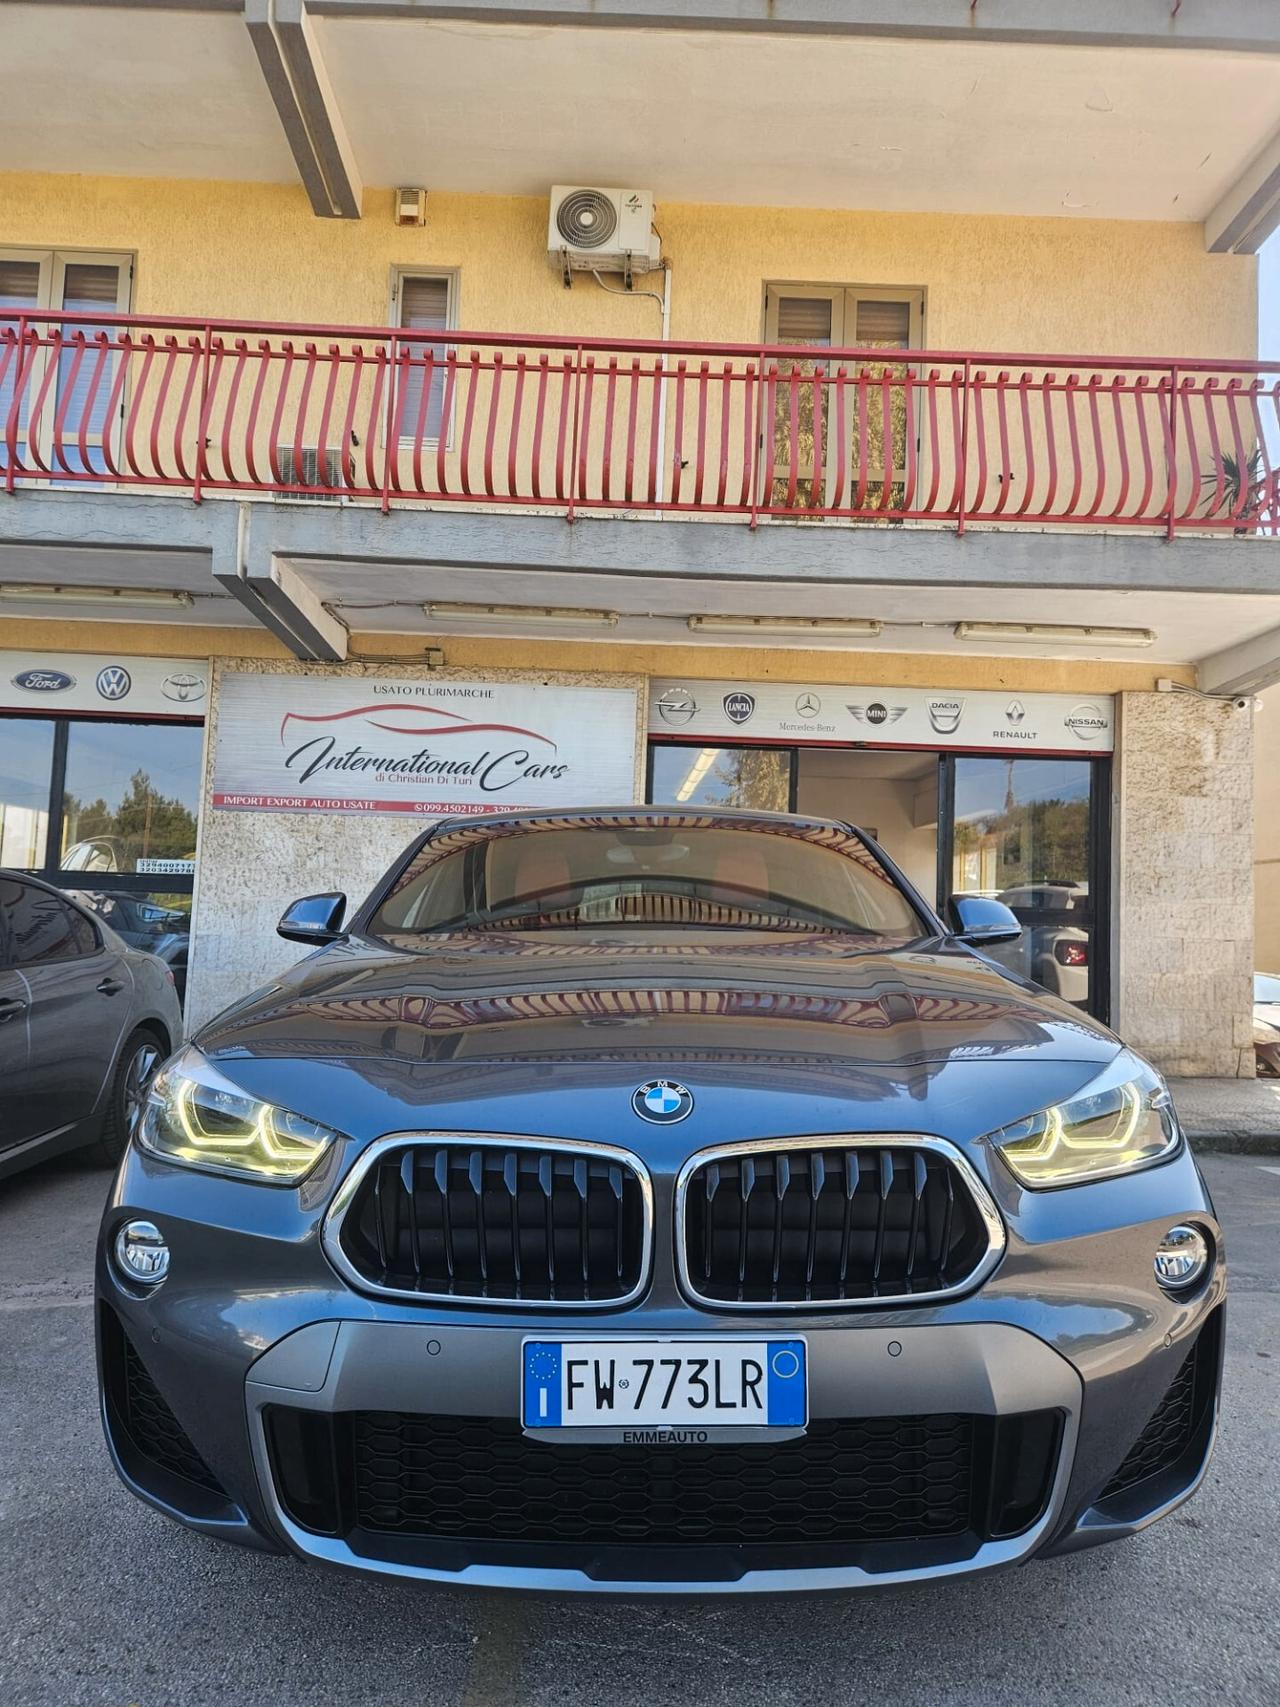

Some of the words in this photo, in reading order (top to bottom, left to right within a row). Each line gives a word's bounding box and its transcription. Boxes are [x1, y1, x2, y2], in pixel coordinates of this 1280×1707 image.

[25, 672, 62, 690] Ford
[373, 685, 412, 696] USATO
[415, 686, 496, 699] PLURIMARCHE
[728, 702, 750, 713] LANCIA
[931, 702, 960, 710] DACIA
[866, 709, 888, 719] MINI
[779, 722, 836, 733] Mercedes-Benz
[1068, 717, 1105, 727] NISSAN
[993, 730, 1039, 740] RENAULT
[285, 735, 490, 784] International
[479, 749, 570, 791] Cars
[375, 773, 385, 783] di
[388, 774, 434, 785] Christian
[437, 776, 449, 785] Di
[453, 776, 473, 786] Turi
[223, 795, 264, 806] IMPORT
[267, 797, 307, 808] EXPORT
[310, 799, 341, 809] AUTO
[343, 800, 377, 810] USATE
[640, 1080, 688, 1094] BMW
[566, 1359, 616, 1410] FW
[632, 1358, 764, 1410] 773LR
[622, 1430, 708, 1444] EMMEAUTO
